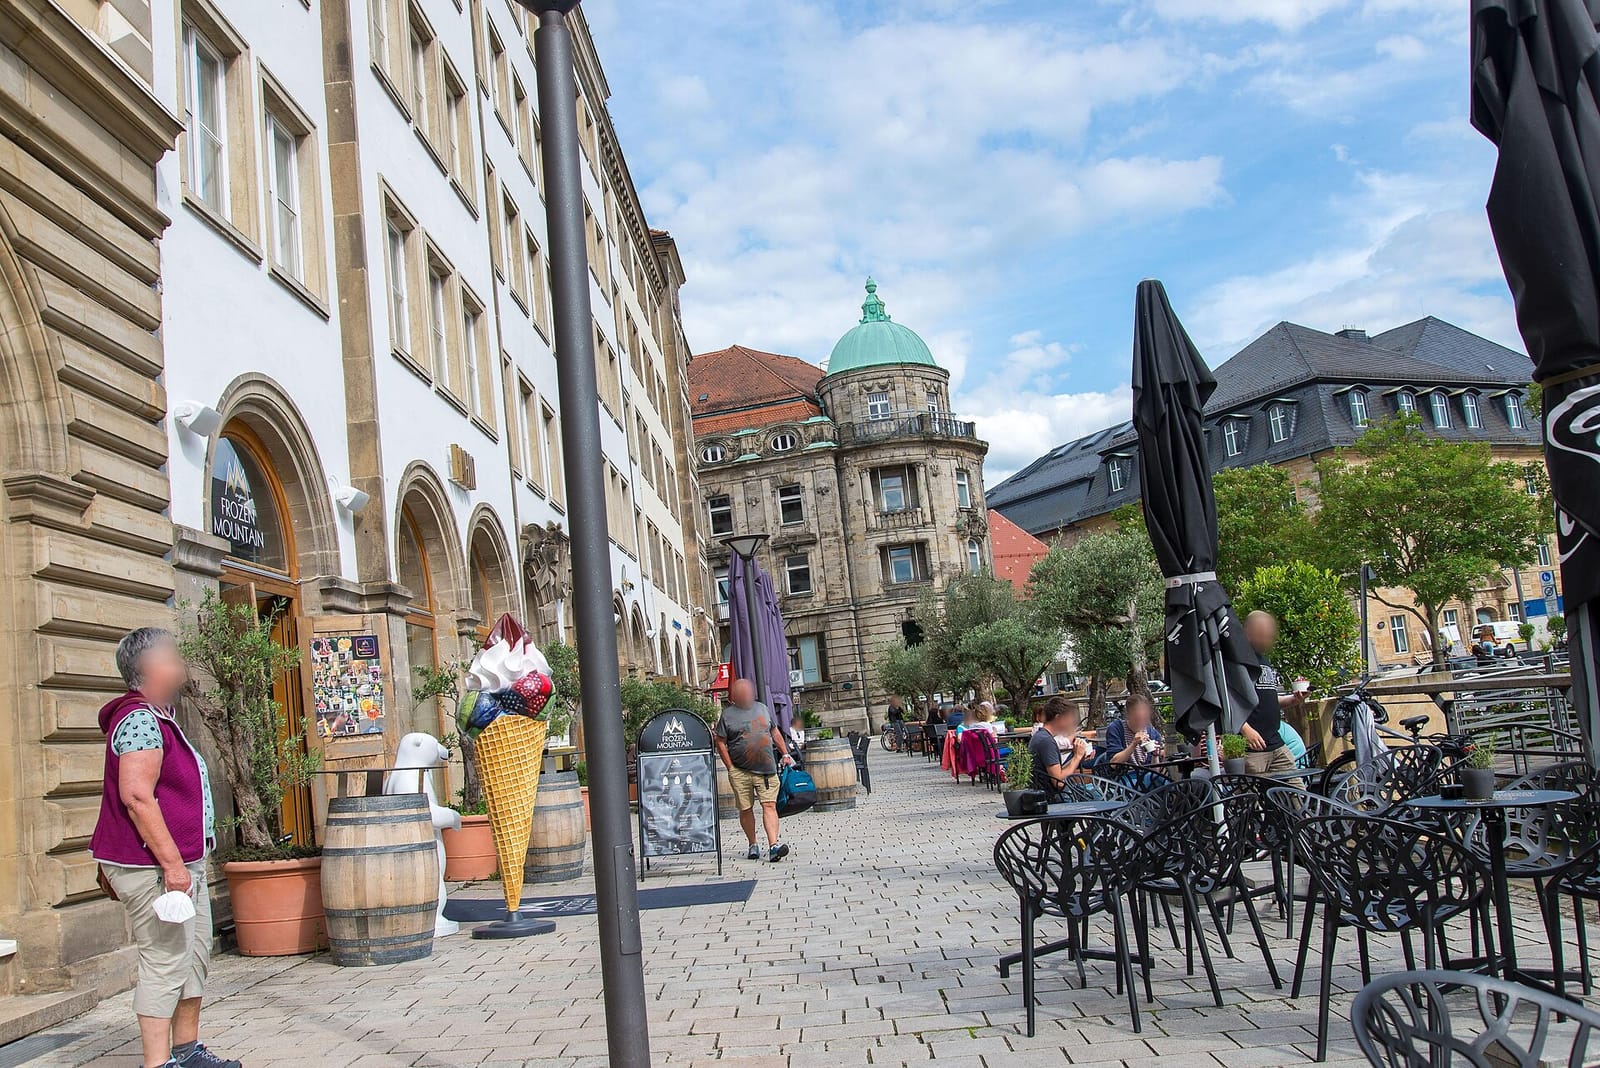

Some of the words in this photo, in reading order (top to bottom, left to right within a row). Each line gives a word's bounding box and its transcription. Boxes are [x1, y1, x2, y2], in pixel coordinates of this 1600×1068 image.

[221, 497, 256, 526] FROZEN
[213, 516, 264, 548] MOUNTAIN
[656, 740, 693, 749] MOUNTAIN
[662, 734, 687, 742] FROZEN
